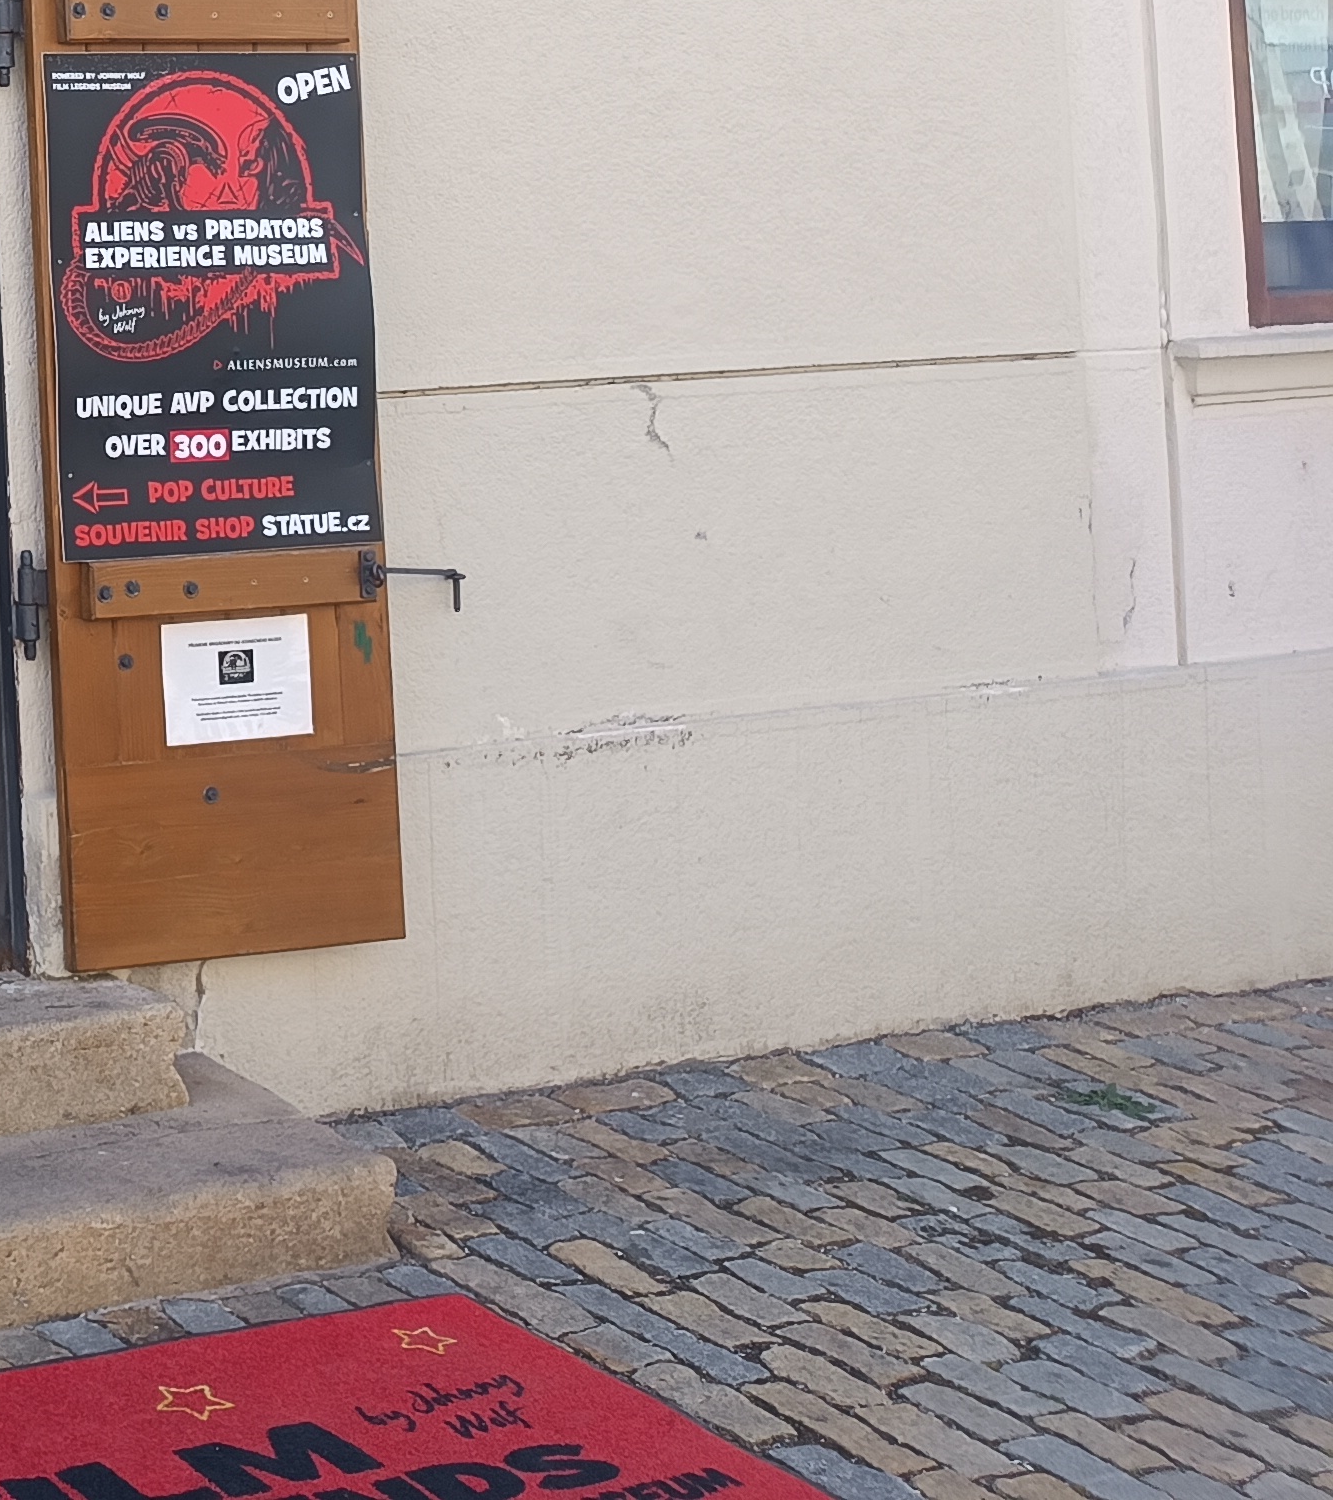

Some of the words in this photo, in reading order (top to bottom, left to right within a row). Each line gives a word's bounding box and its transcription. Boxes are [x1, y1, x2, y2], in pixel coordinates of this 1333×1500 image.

[277, 64, 352, 105] OPEN
[84, 221, 165, 243] ALIENS
[204, 218, 324, 241] PREDATORS
[85, 245, 227, 269] EXPERIENCE
[234, 243, 328, 267] MUSEUM
[227, 357, 358, 371] ALIENSMUSEUM.com
[76, 392, 163, 419] UNIQUE
[170, 391, 215, 414] AVP
[222, 386, 358, 413] COLLECTION
[105, 433, 167, 458] OVER
[174, 433, 227, 459] 300
[232, 427, 331, 452] EXHIBITS
[148, 480, 193, 504] POP
[201, 475, 294, 500] CULTURE
[74, 520, 188, 547] SOUVENIR
[196, 515, 255, 540] SHOP
[354, 1405, 417, 1433] by
